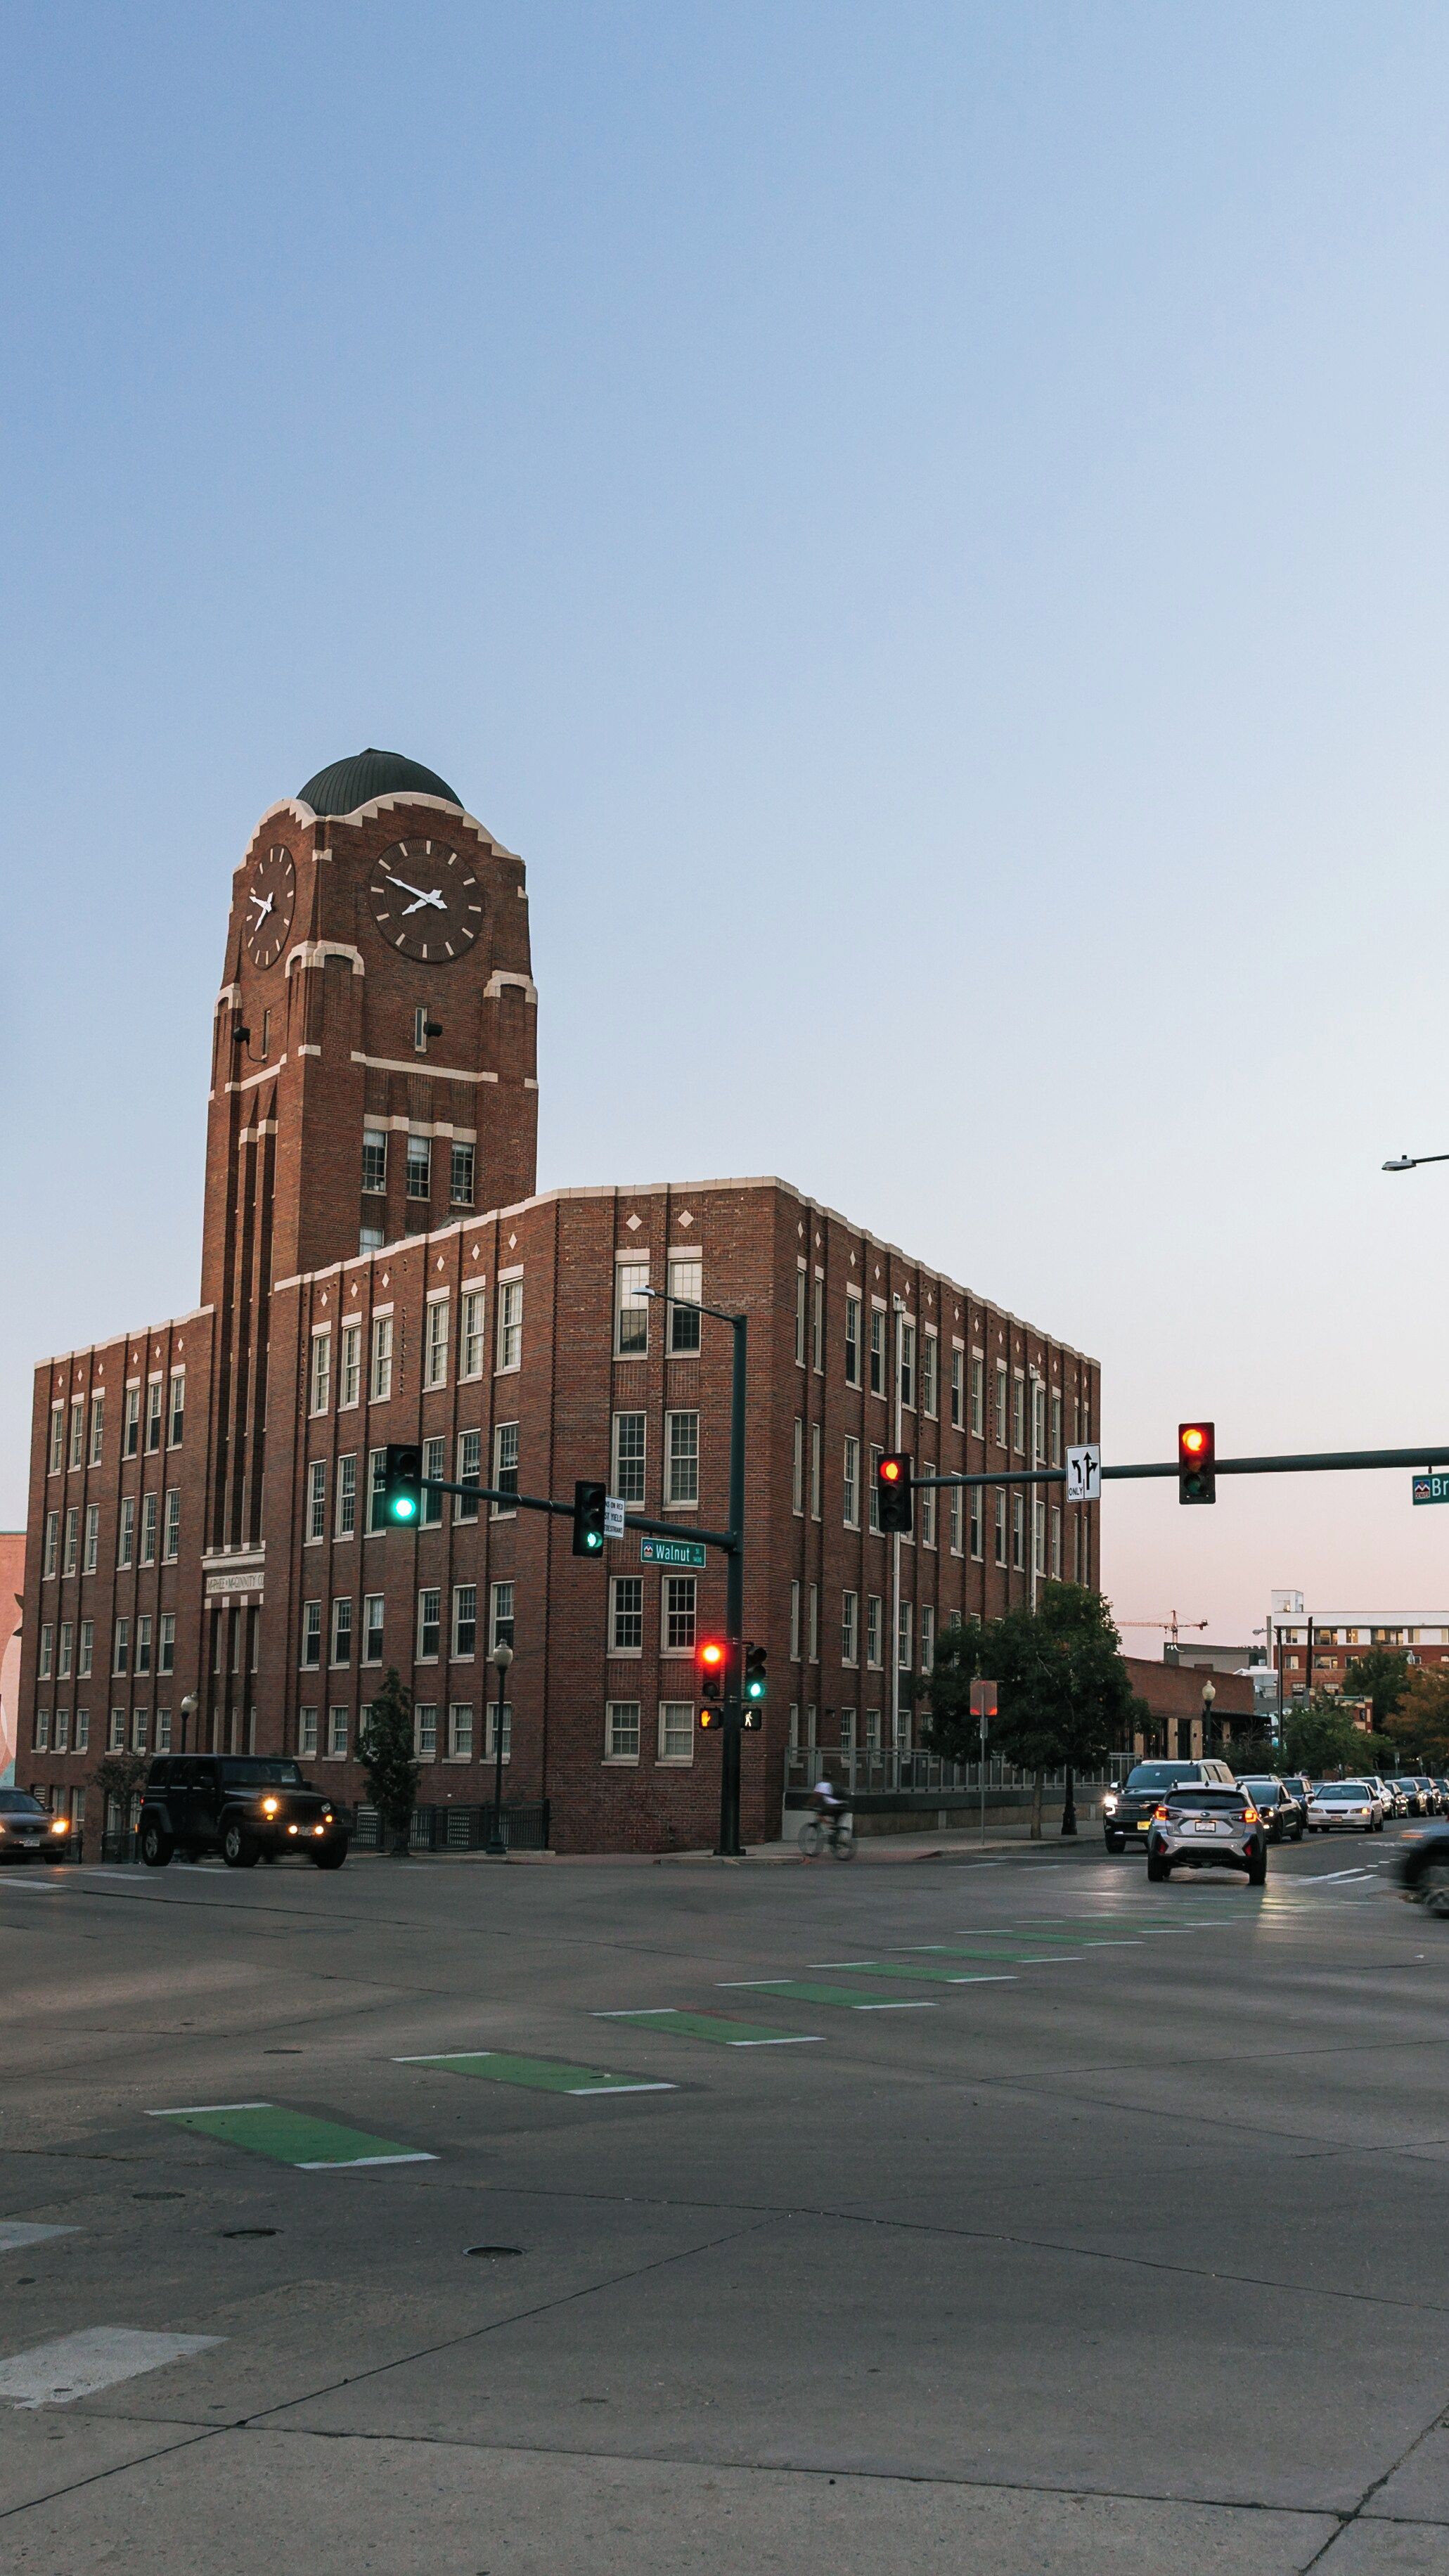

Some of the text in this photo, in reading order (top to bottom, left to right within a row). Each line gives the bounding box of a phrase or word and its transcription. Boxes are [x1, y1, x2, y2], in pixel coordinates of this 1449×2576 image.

[1069, 1487, 1083, 1496] ONLY
[611, 1513, 623, 1522] YIELD
[656, 1545, 690, 1561] Walnut
